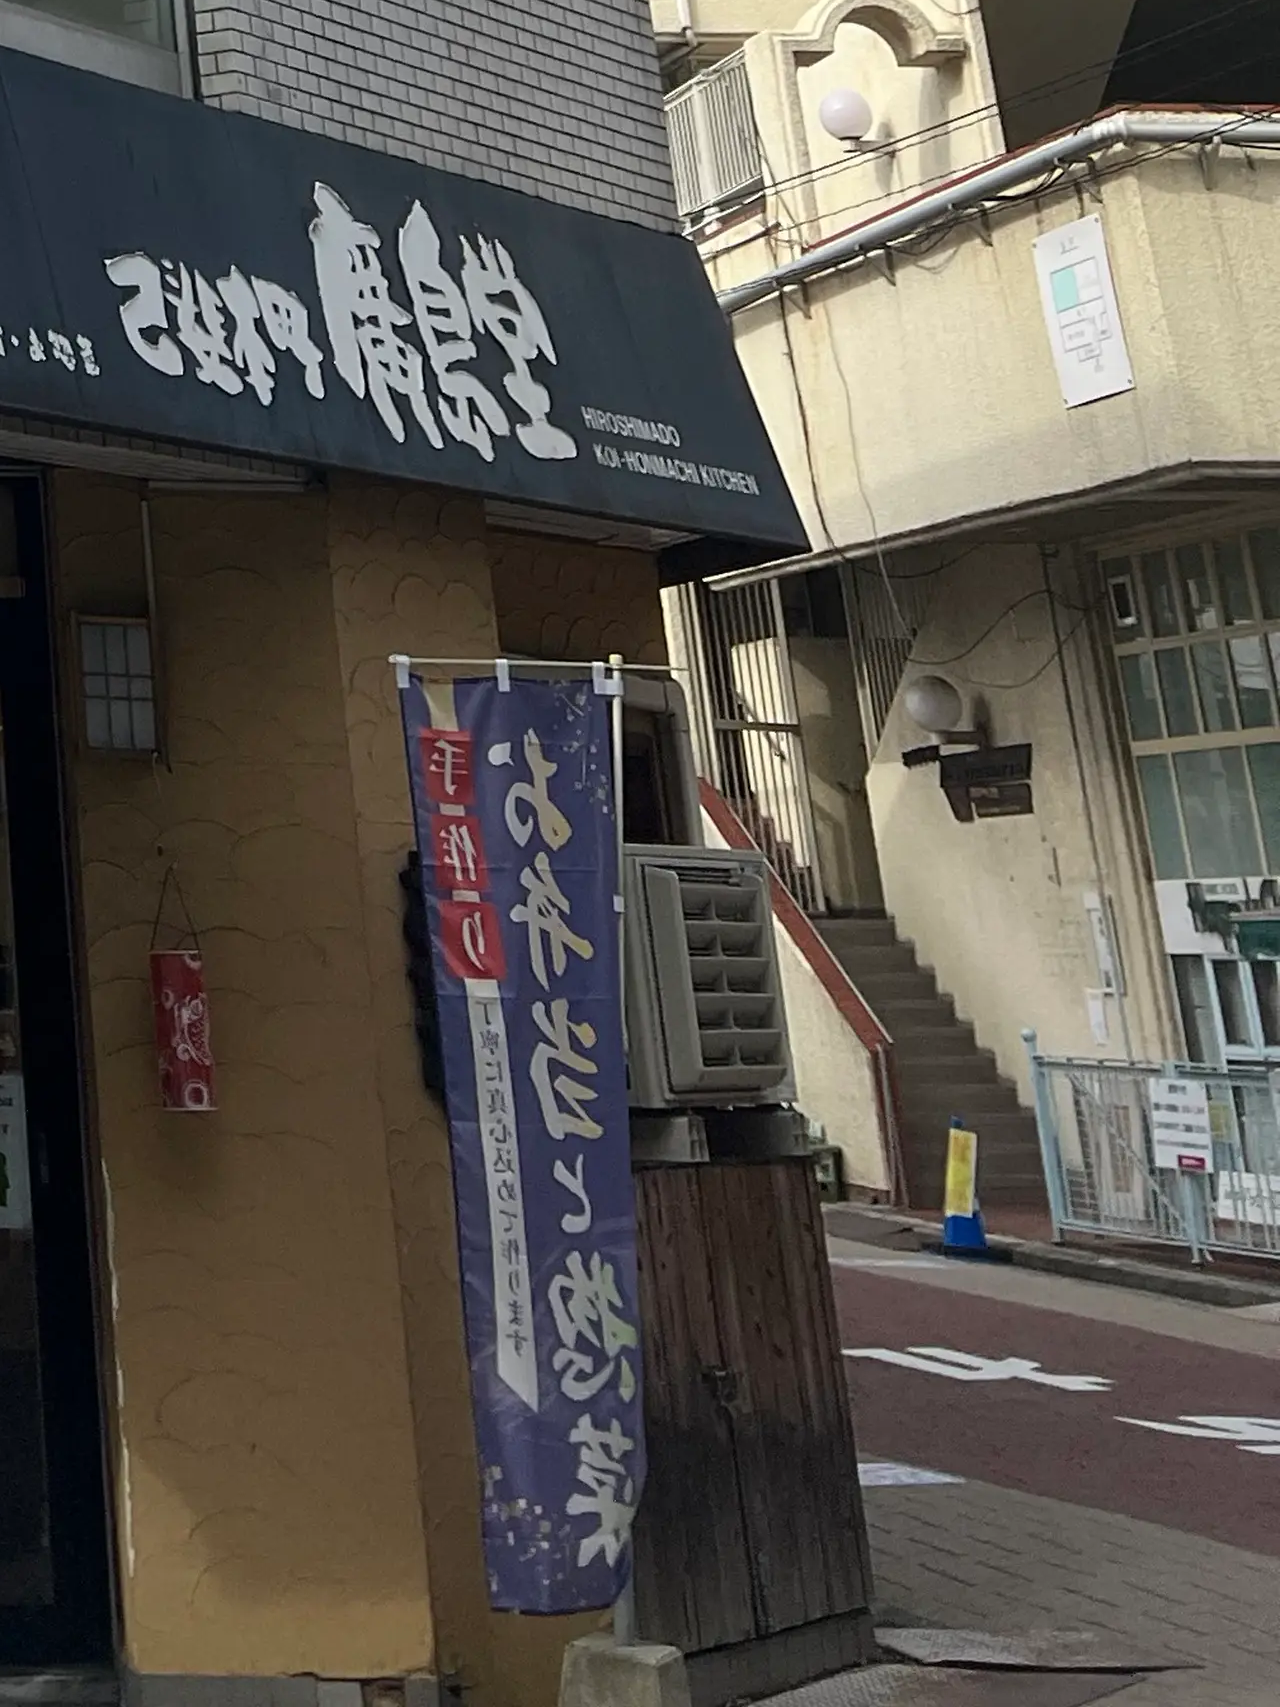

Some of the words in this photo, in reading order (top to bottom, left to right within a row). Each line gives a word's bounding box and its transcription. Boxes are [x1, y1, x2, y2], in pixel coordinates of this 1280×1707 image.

[581, 405, 682, 449] HIROSHIMADO
[592, 442, 700, 485] KOI-HONMACHI
[697, 465, 762, 496] KITCHEN
